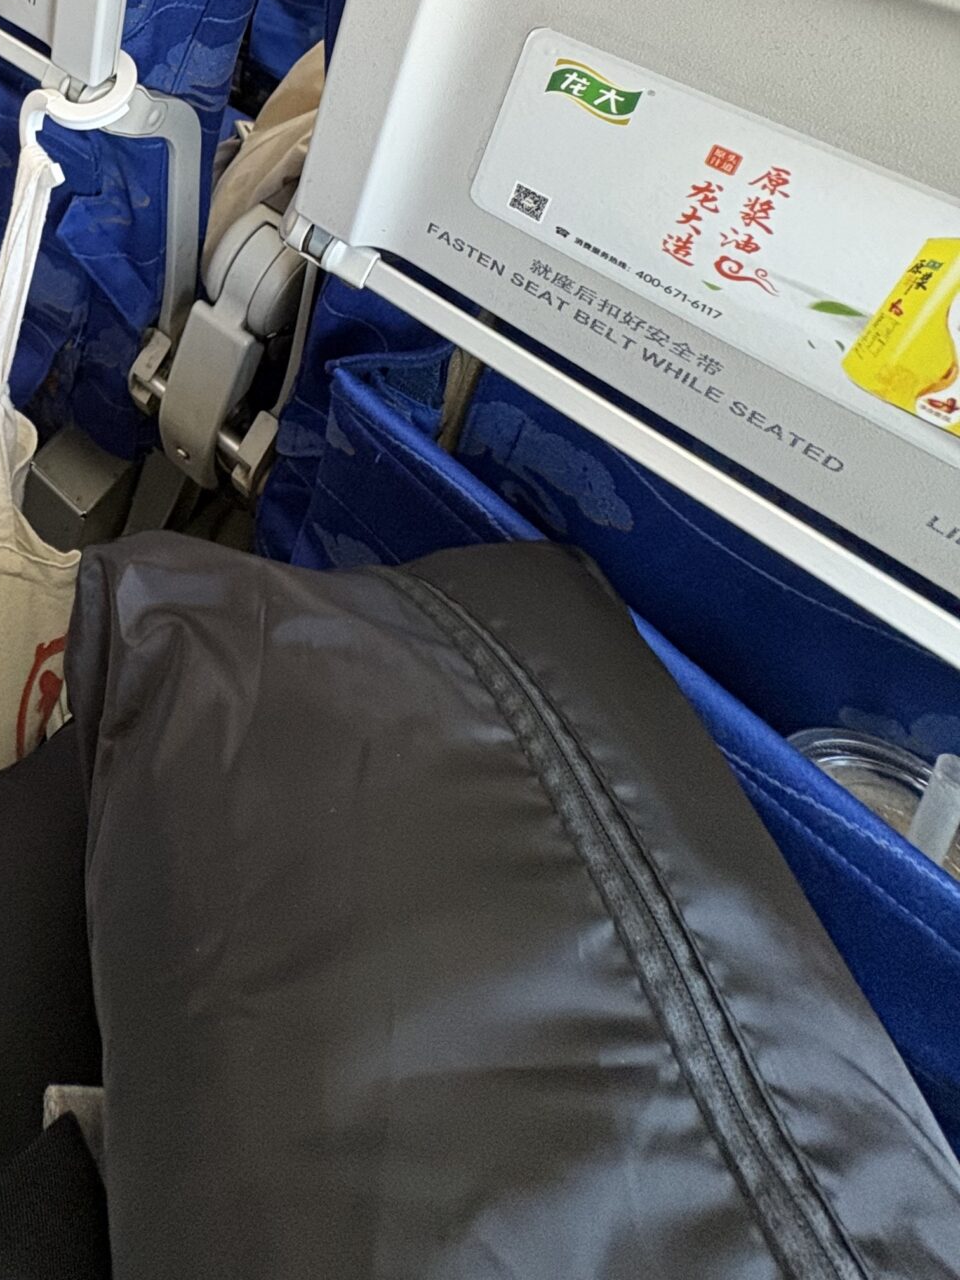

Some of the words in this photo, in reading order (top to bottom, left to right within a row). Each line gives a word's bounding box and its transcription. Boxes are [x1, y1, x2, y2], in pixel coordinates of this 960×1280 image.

[560, 72, 625, 114] 龙大
[529, 258, 725, 376] 就座后扣好安全带
[635, 270, 723, 319] 400-671-6117
[426, 222, 506, 276] FASTEN
[510, 272, 570, 312] SEAT
[573, 309, 637, 351] BELT
[642, 347, 725, 404] WHILE
[729, 401, 844, 473] SEATED
